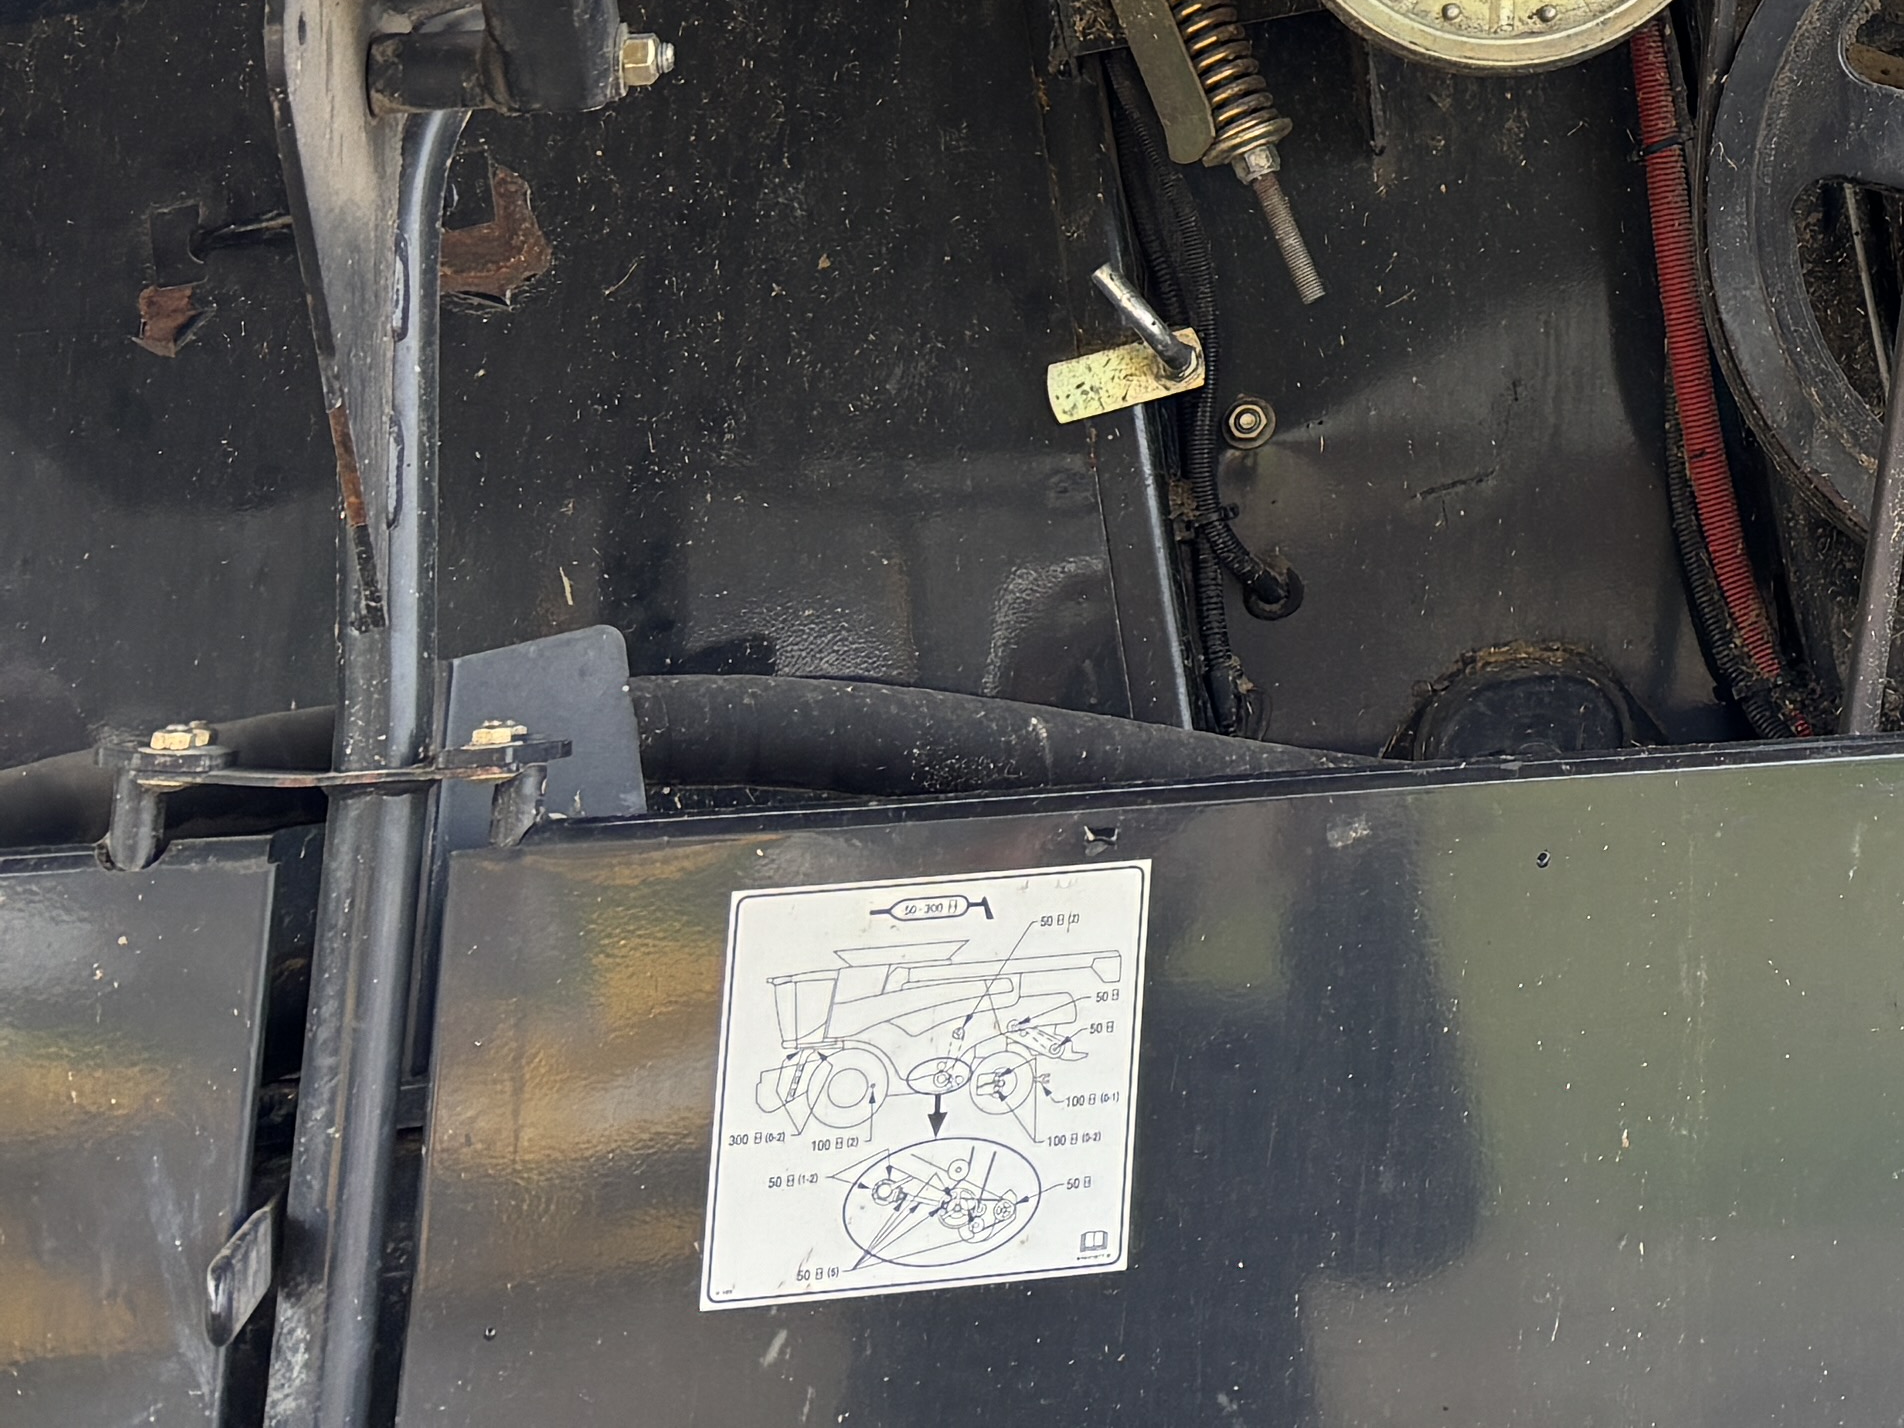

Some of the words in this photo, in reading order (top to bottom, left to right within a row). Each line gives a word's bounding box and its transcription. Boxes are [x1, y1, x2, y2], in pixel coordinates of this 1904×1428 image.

[1040, 915, 1053, 927] 50
[1095, 991, 1109, 1003] 50
[1089, 1022, 1103, 1034] 50
[1066, 1094, 1085, 1108] 100
[728, 1134, 749, 1146] 300
[765, 1131, 786, 1143] (0-2)
[811, 1139, 831, 1151] 100
[846, 1136, 859, 1148] (2)
[1047, 1134, 1067, 1147] 100
[768, 1176, 782, 1188] 50
[798, 1173, 819, 1185] (1-2)
[1066, 1177, 1080, 1190] 50
[796, 1270, 811, 1282] 50
[827, 1266, 840, 1278] (5)
